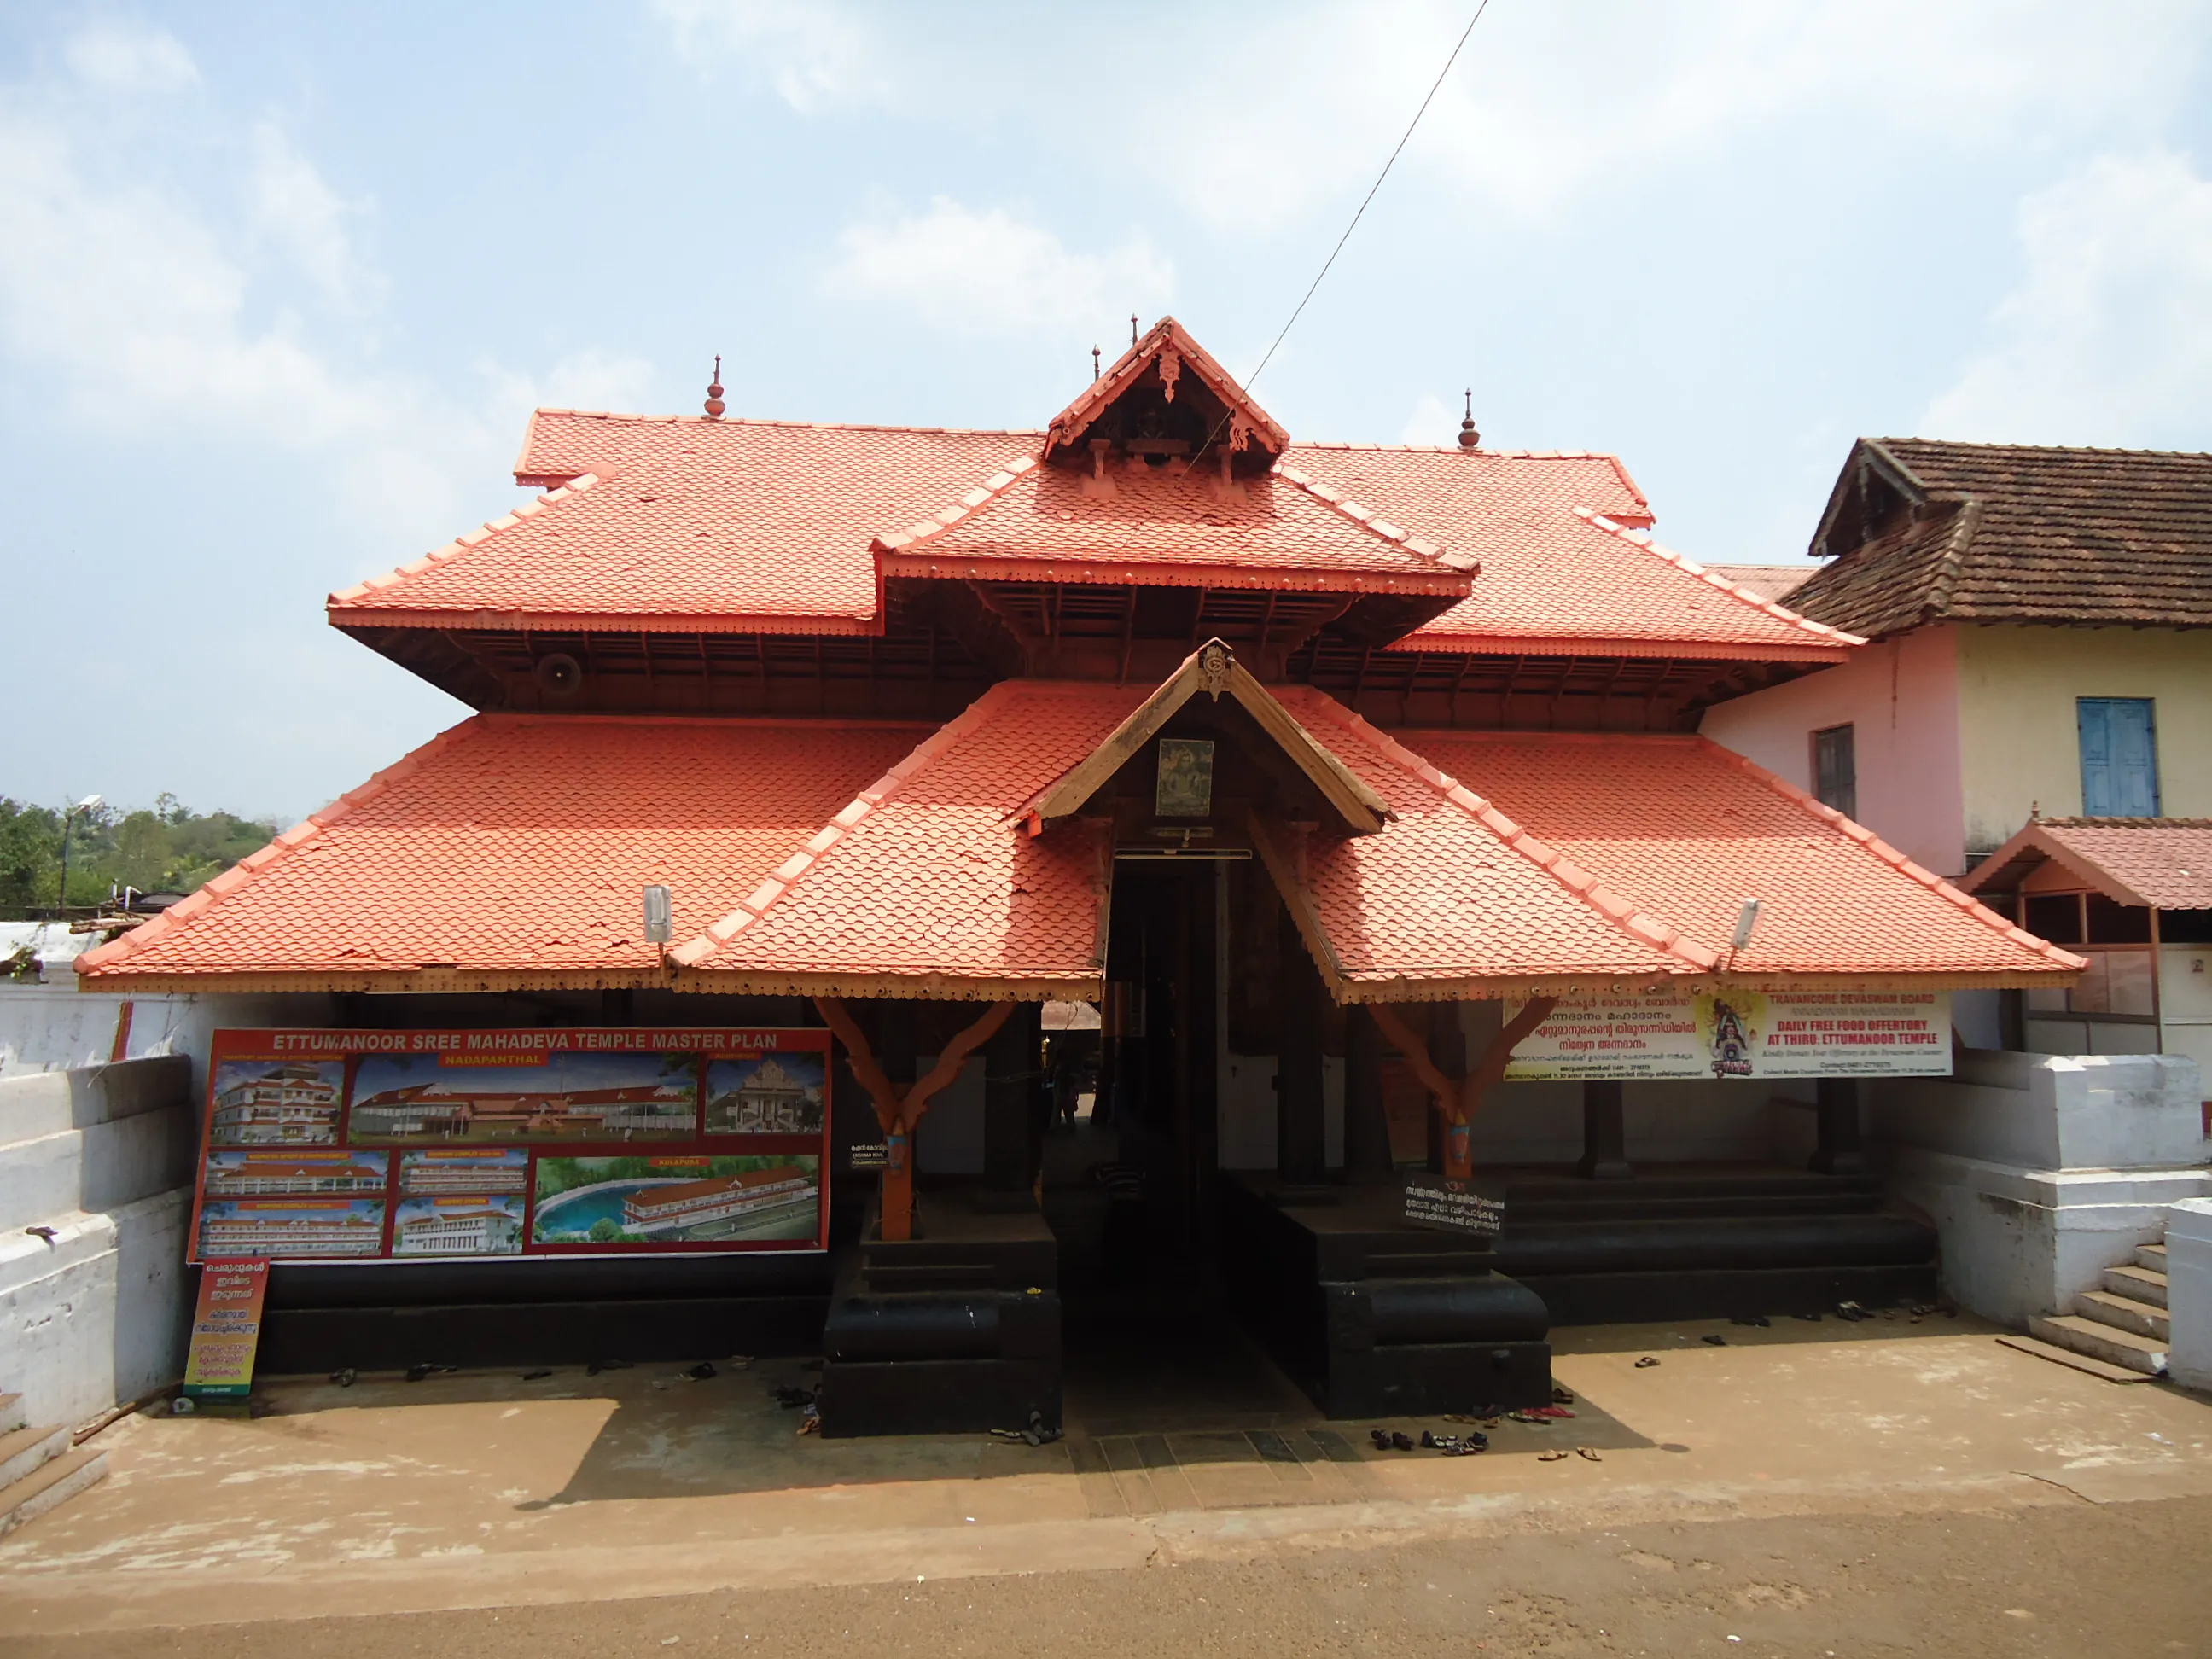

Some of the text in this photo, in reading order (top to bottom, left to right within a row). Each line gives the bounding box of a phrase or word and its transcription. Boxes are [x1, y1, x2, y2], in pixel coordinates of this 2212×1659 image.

[1770, 993, 1936, 1004] TRAVANCORE DEVASWAM BOARD
[1607, 1011, 1671, 1021] മഹാദാനം
[1615, 1022, 1697, 1037] തിരുസന്നിധിയിൽ
[1778, 1020, 1928, 1032] DAILY FREE FOOD OFFERTORY
[273, 1033, 777, 1050] ETTUMANOOR SREE MAHADEVA TEMPLE MASTER PLAN
[1598, 1039, 1646, 1050] അന്നദാനം
[1767, 1033, 1938, 1045] AT THIRU: ETTUMANOOR TEMPLE
[445, 1055, 540, 1065] NADAPANTHAL
